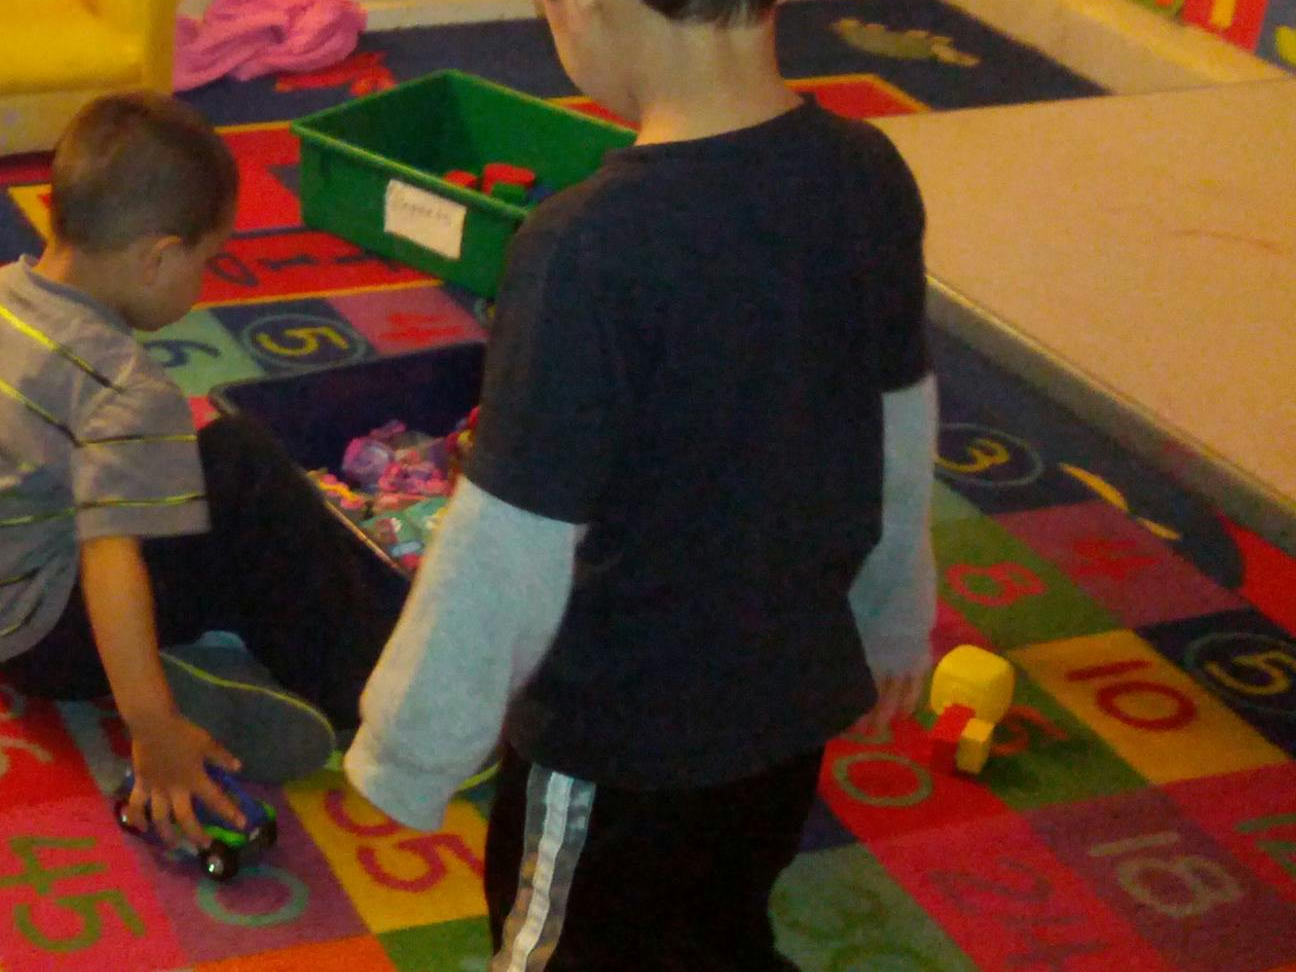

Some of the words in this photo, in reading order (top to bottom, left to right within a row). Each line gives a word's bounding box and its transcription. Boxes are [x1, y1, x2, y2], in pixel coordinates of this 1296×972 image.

[255, 325, 350, 356] 5
[944, 561, 1048, 607] 8
[1063, 659, 1198, 731] 10
[1087, 831, 1245, 920] 18
